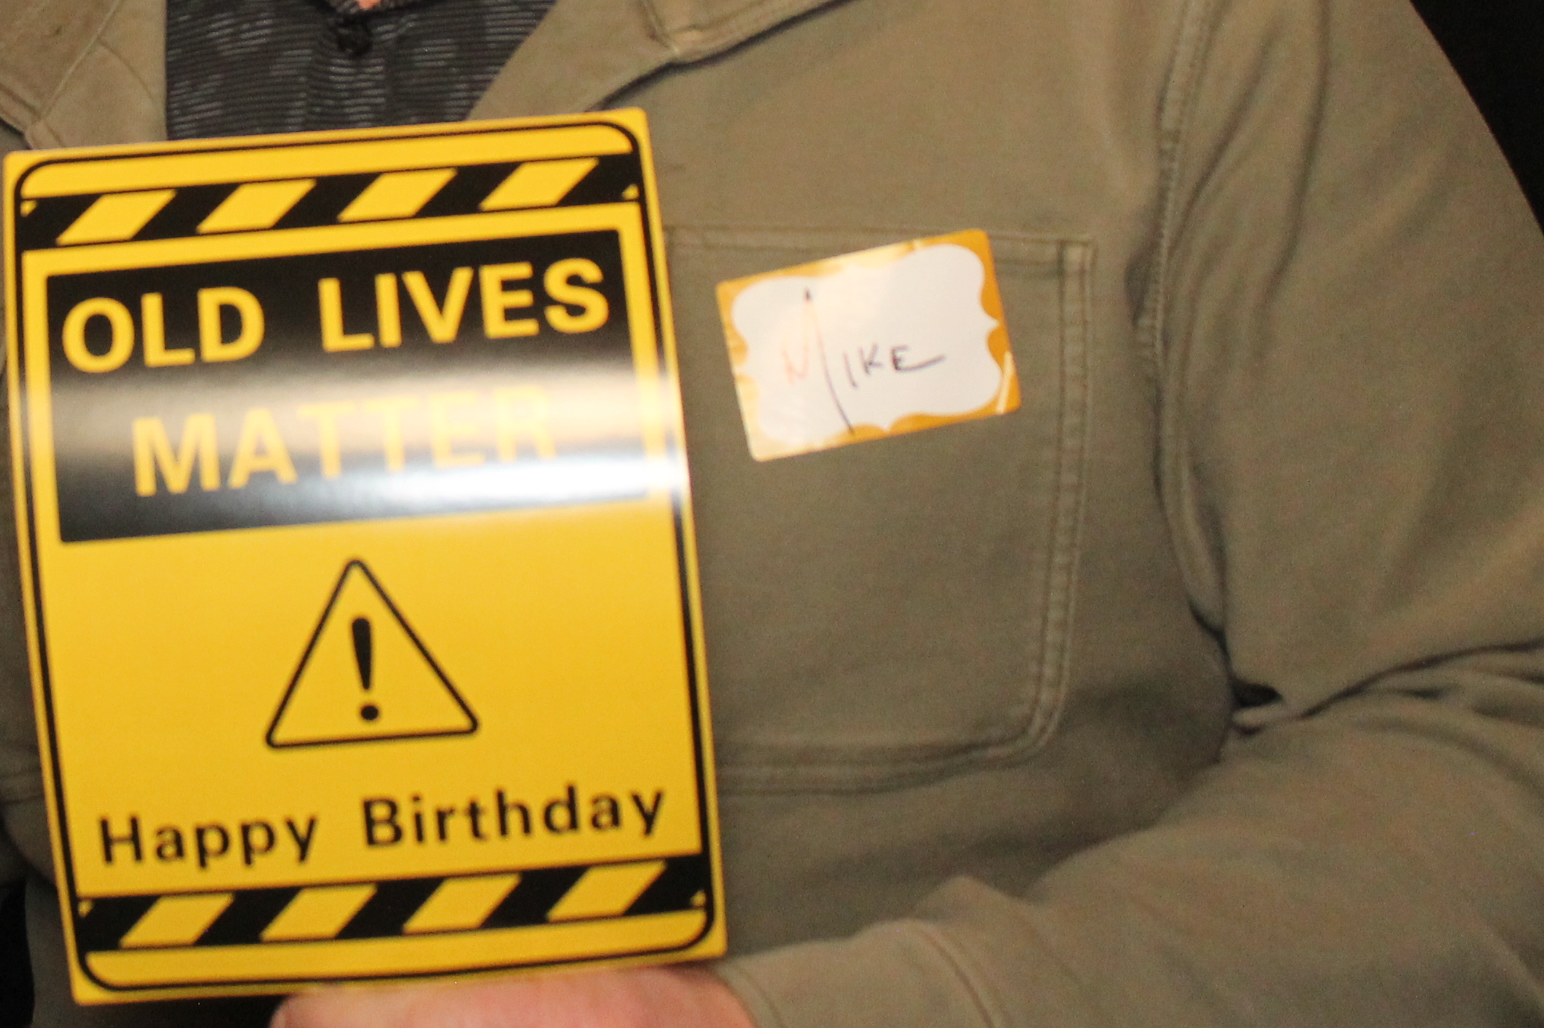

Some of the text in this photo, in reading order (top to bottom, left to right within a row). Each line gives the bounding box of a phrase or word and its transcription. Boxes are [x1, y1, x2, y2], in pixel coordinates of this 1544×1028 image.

[62, 258, 609, 373] OLD LIVES
[132, 384, 558, 498] MATTER
[98, 782, 665, 871] Happy Birthday
